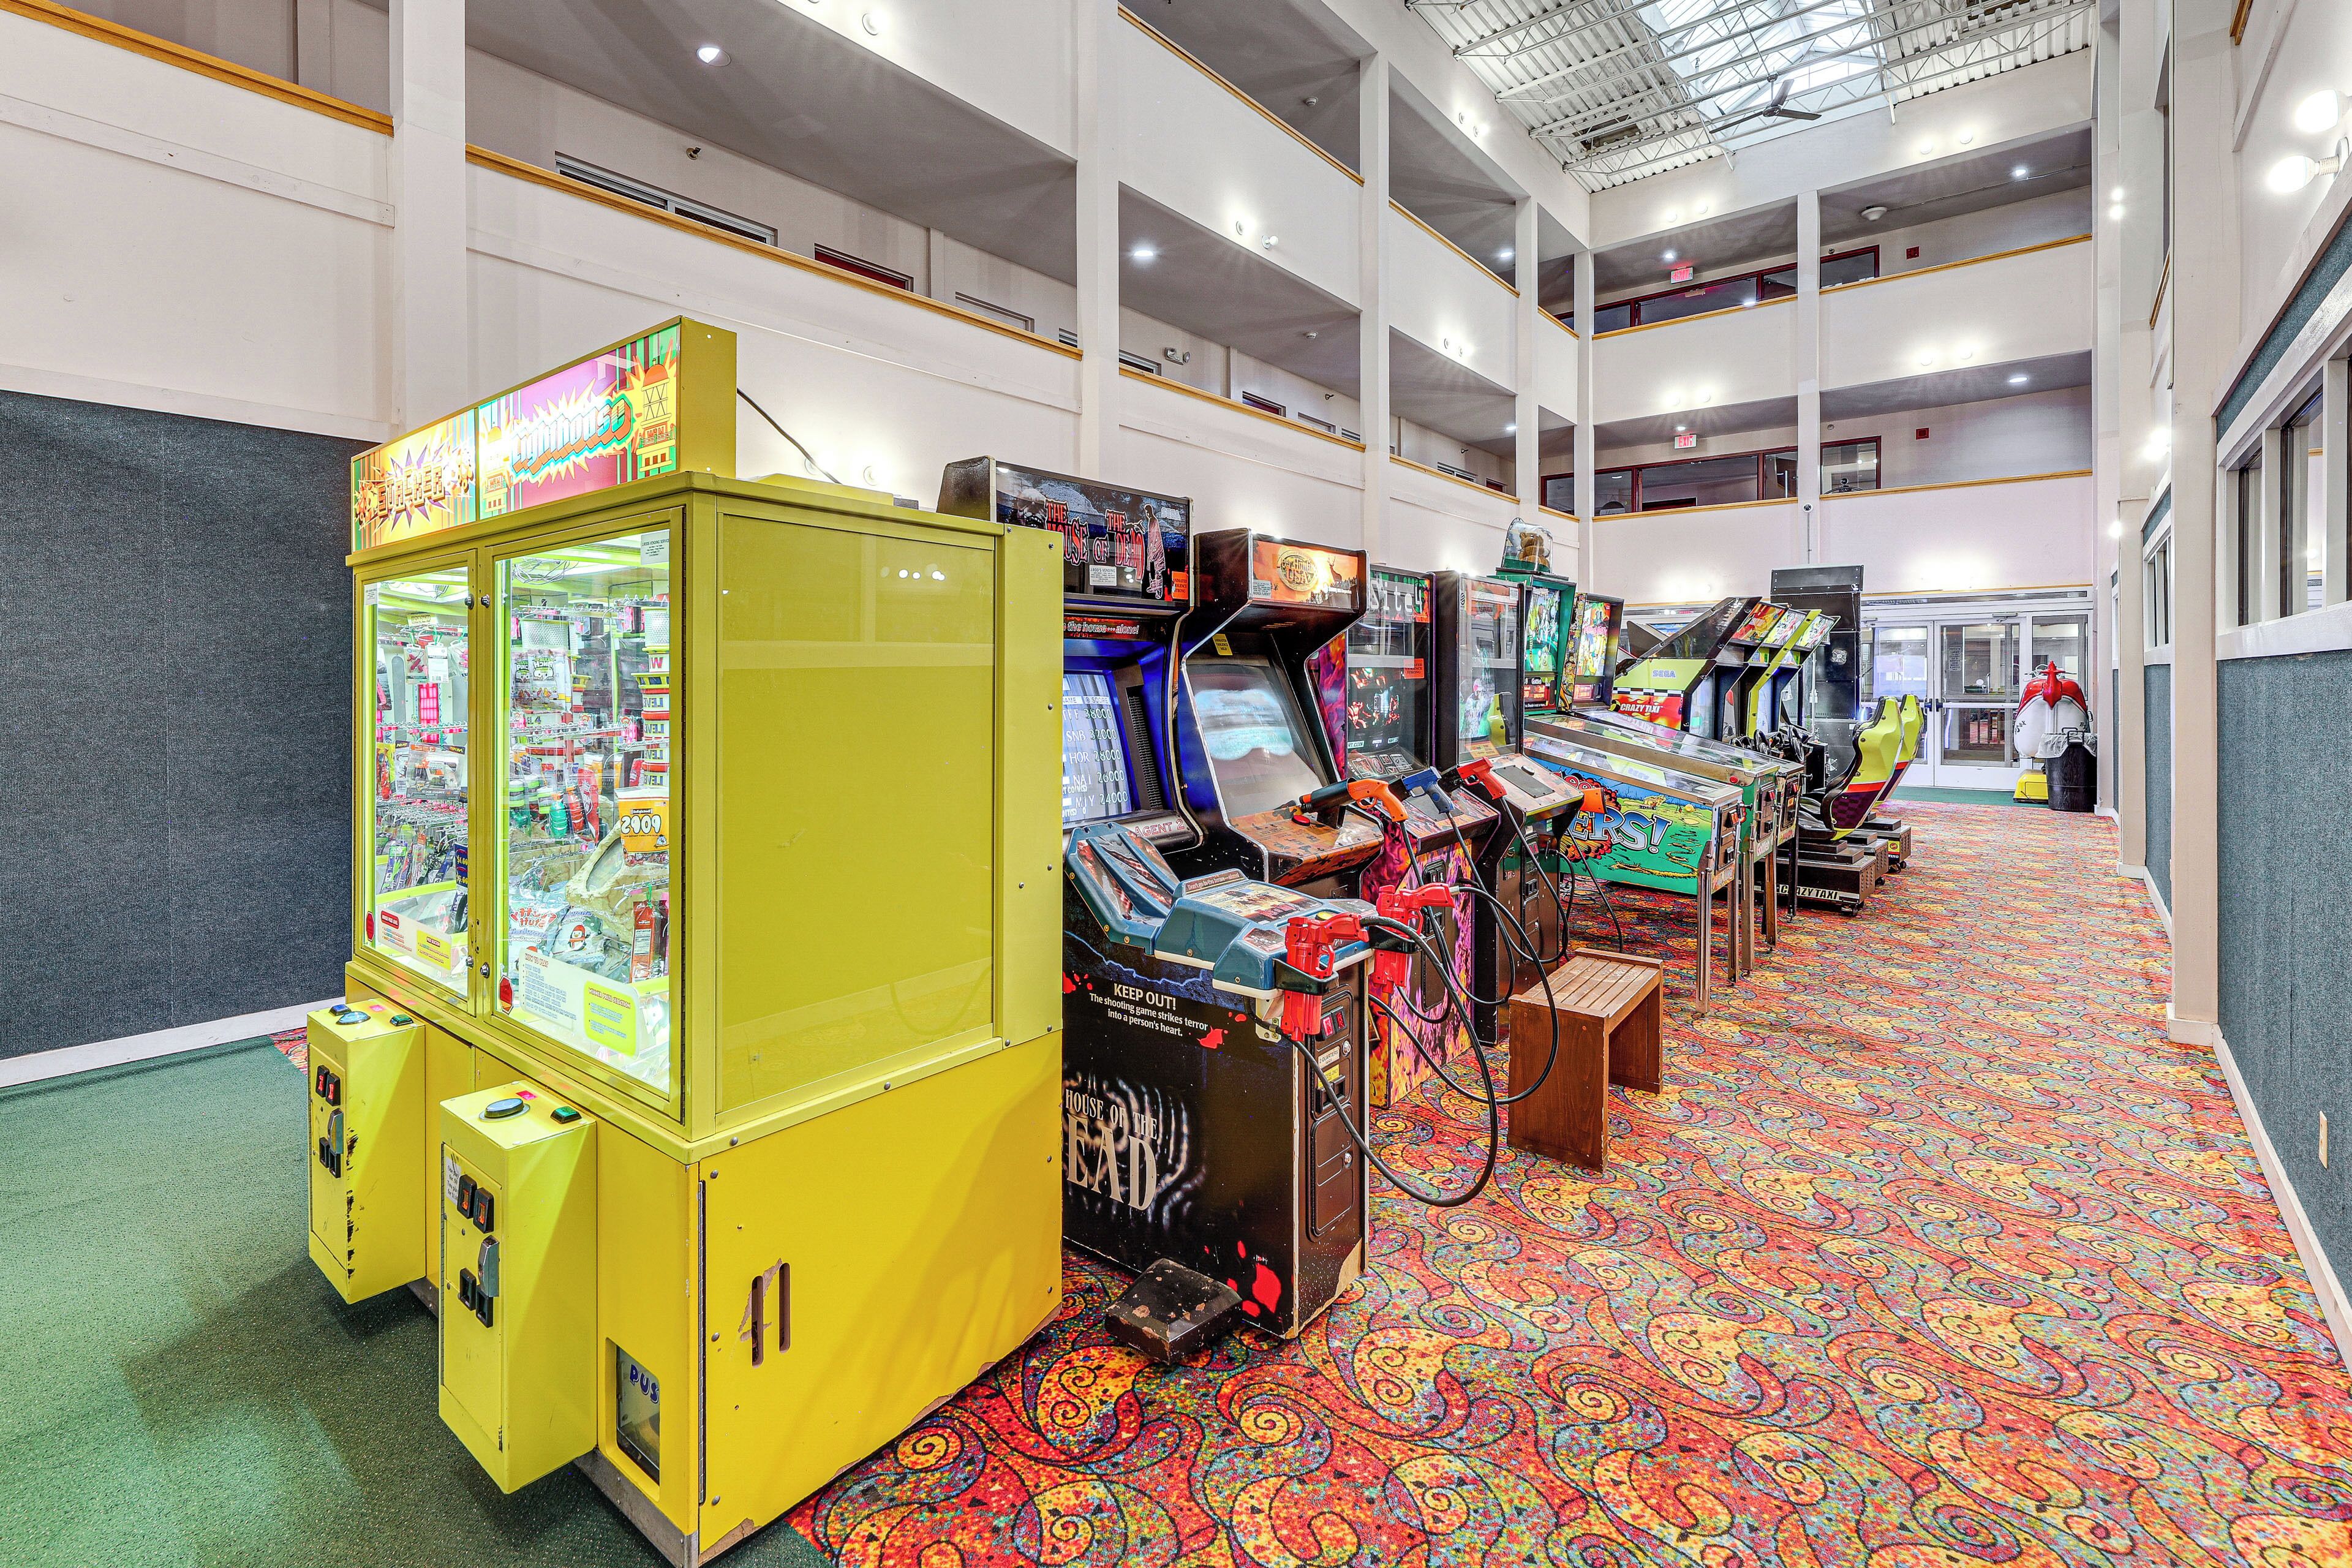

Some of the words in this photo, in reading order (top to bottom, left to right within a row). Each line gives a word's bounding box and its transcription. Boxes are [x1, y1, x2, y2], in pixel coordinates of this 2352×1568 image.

[1679, 436, 1694, 447] EXIT
[377, 463, 445, 519] STACKER
[1045, 499, 1068, 524] THE
[1161, 507, 1181, 520] SEGA
[1106, 510, 1127, 532] THE
[1047, 518, 1088, 565] USE
[1093, 535, 1109, 563] OF
[1115, 529, 1145, 581] DEAD
[1286, 568, 1310, 584] USA
[1068, 621, 1082, 631] the
[1653, 669, 1676, 678] SEGA
[1084, 708, 1112, 719] 38000
[1620, 703, 1645, 712] CRAZY
[1066, 729, 1086, 742] SNB
[1090, 728, 1117, 741] 32000
[1069, 752, 1090, 764] HOR
[1094, 749, 1121, 761] 28000
[1097, 770, 1125, 783] 26000
[1100, 791, 1128, 804] 24000
[1134, 822, 1172, 836] AGENT
[1176, 818, 1185, 830] 2
[1781, 884, 1814, 896] CAZY
[1815, 889, 1838, 900] TAXI
[1114, 983, 1144, 1001] KEEP
[1145, 991, 1177, 1011] OUT!
[1089, 993, 1103, 1003] The
[1104, 997, 1135, 1014] shooting
[1136, 1006, 1157, 1017] game
[1158, 1011, 1183, 1025] strikes
[1185, 1017, 1208, 1030] terror
[1107, 1009, 1122, 1020] into
[1129, 1016, 1159, 1030] person's
[1160, 1023, 1183, 1036] heart.
[1322, 1050, 1338, 1062] QUARTERS
[1066, 1088, 1103, 1120] HOUSE
[1133, 1112, 1157, 1140] THE
[630, 1364, 659, 1404] PUS
